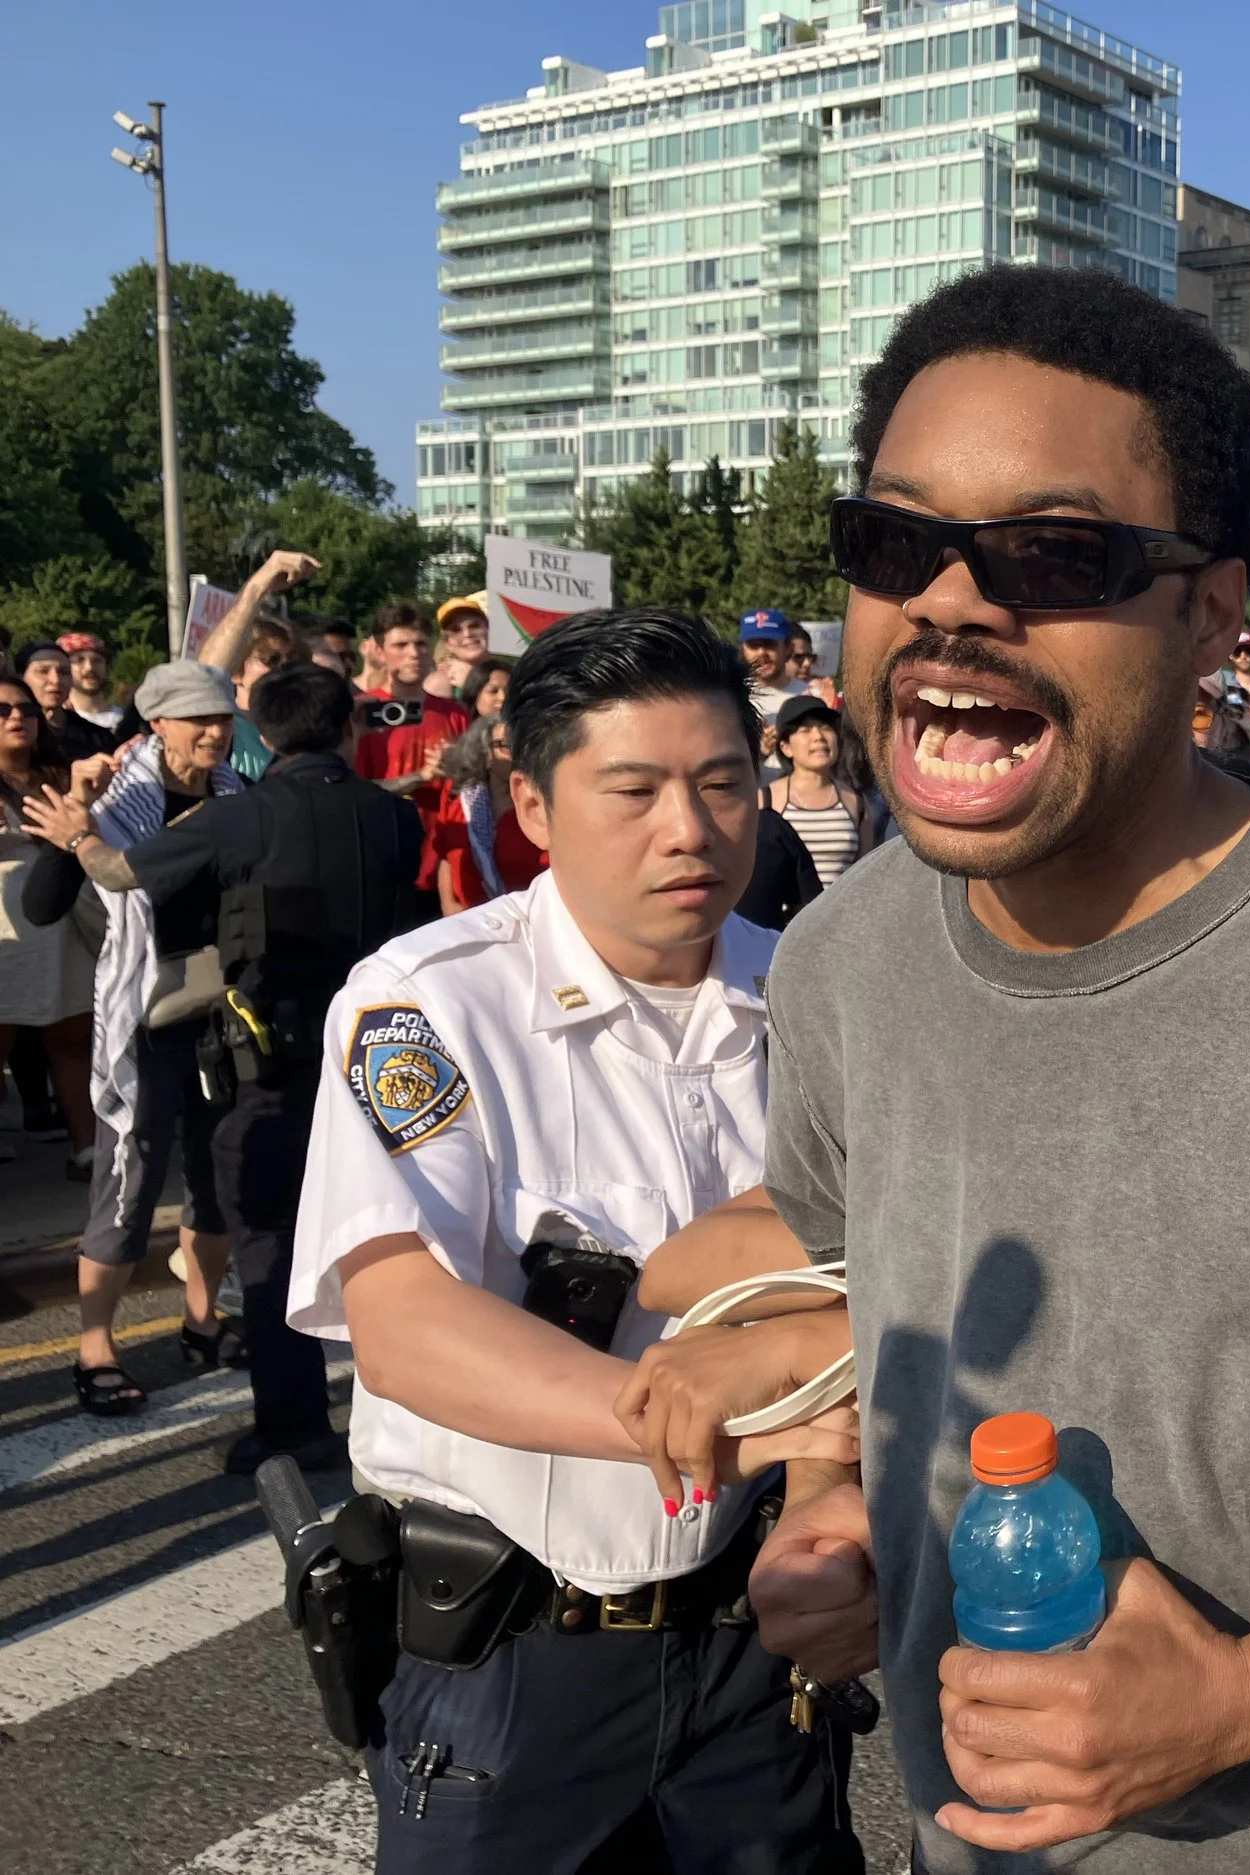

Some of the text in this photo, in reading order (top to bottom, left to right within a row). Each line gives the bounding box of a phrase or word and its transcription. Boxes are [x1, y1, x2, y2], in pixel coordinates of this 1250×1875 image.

[529, 550, 572, 573] FREE
[503, 566, 596, 599] PALESTINE
[391, 1012, 432, 1031] POL
[400, 1079, 469, 1141] NEW YORK
